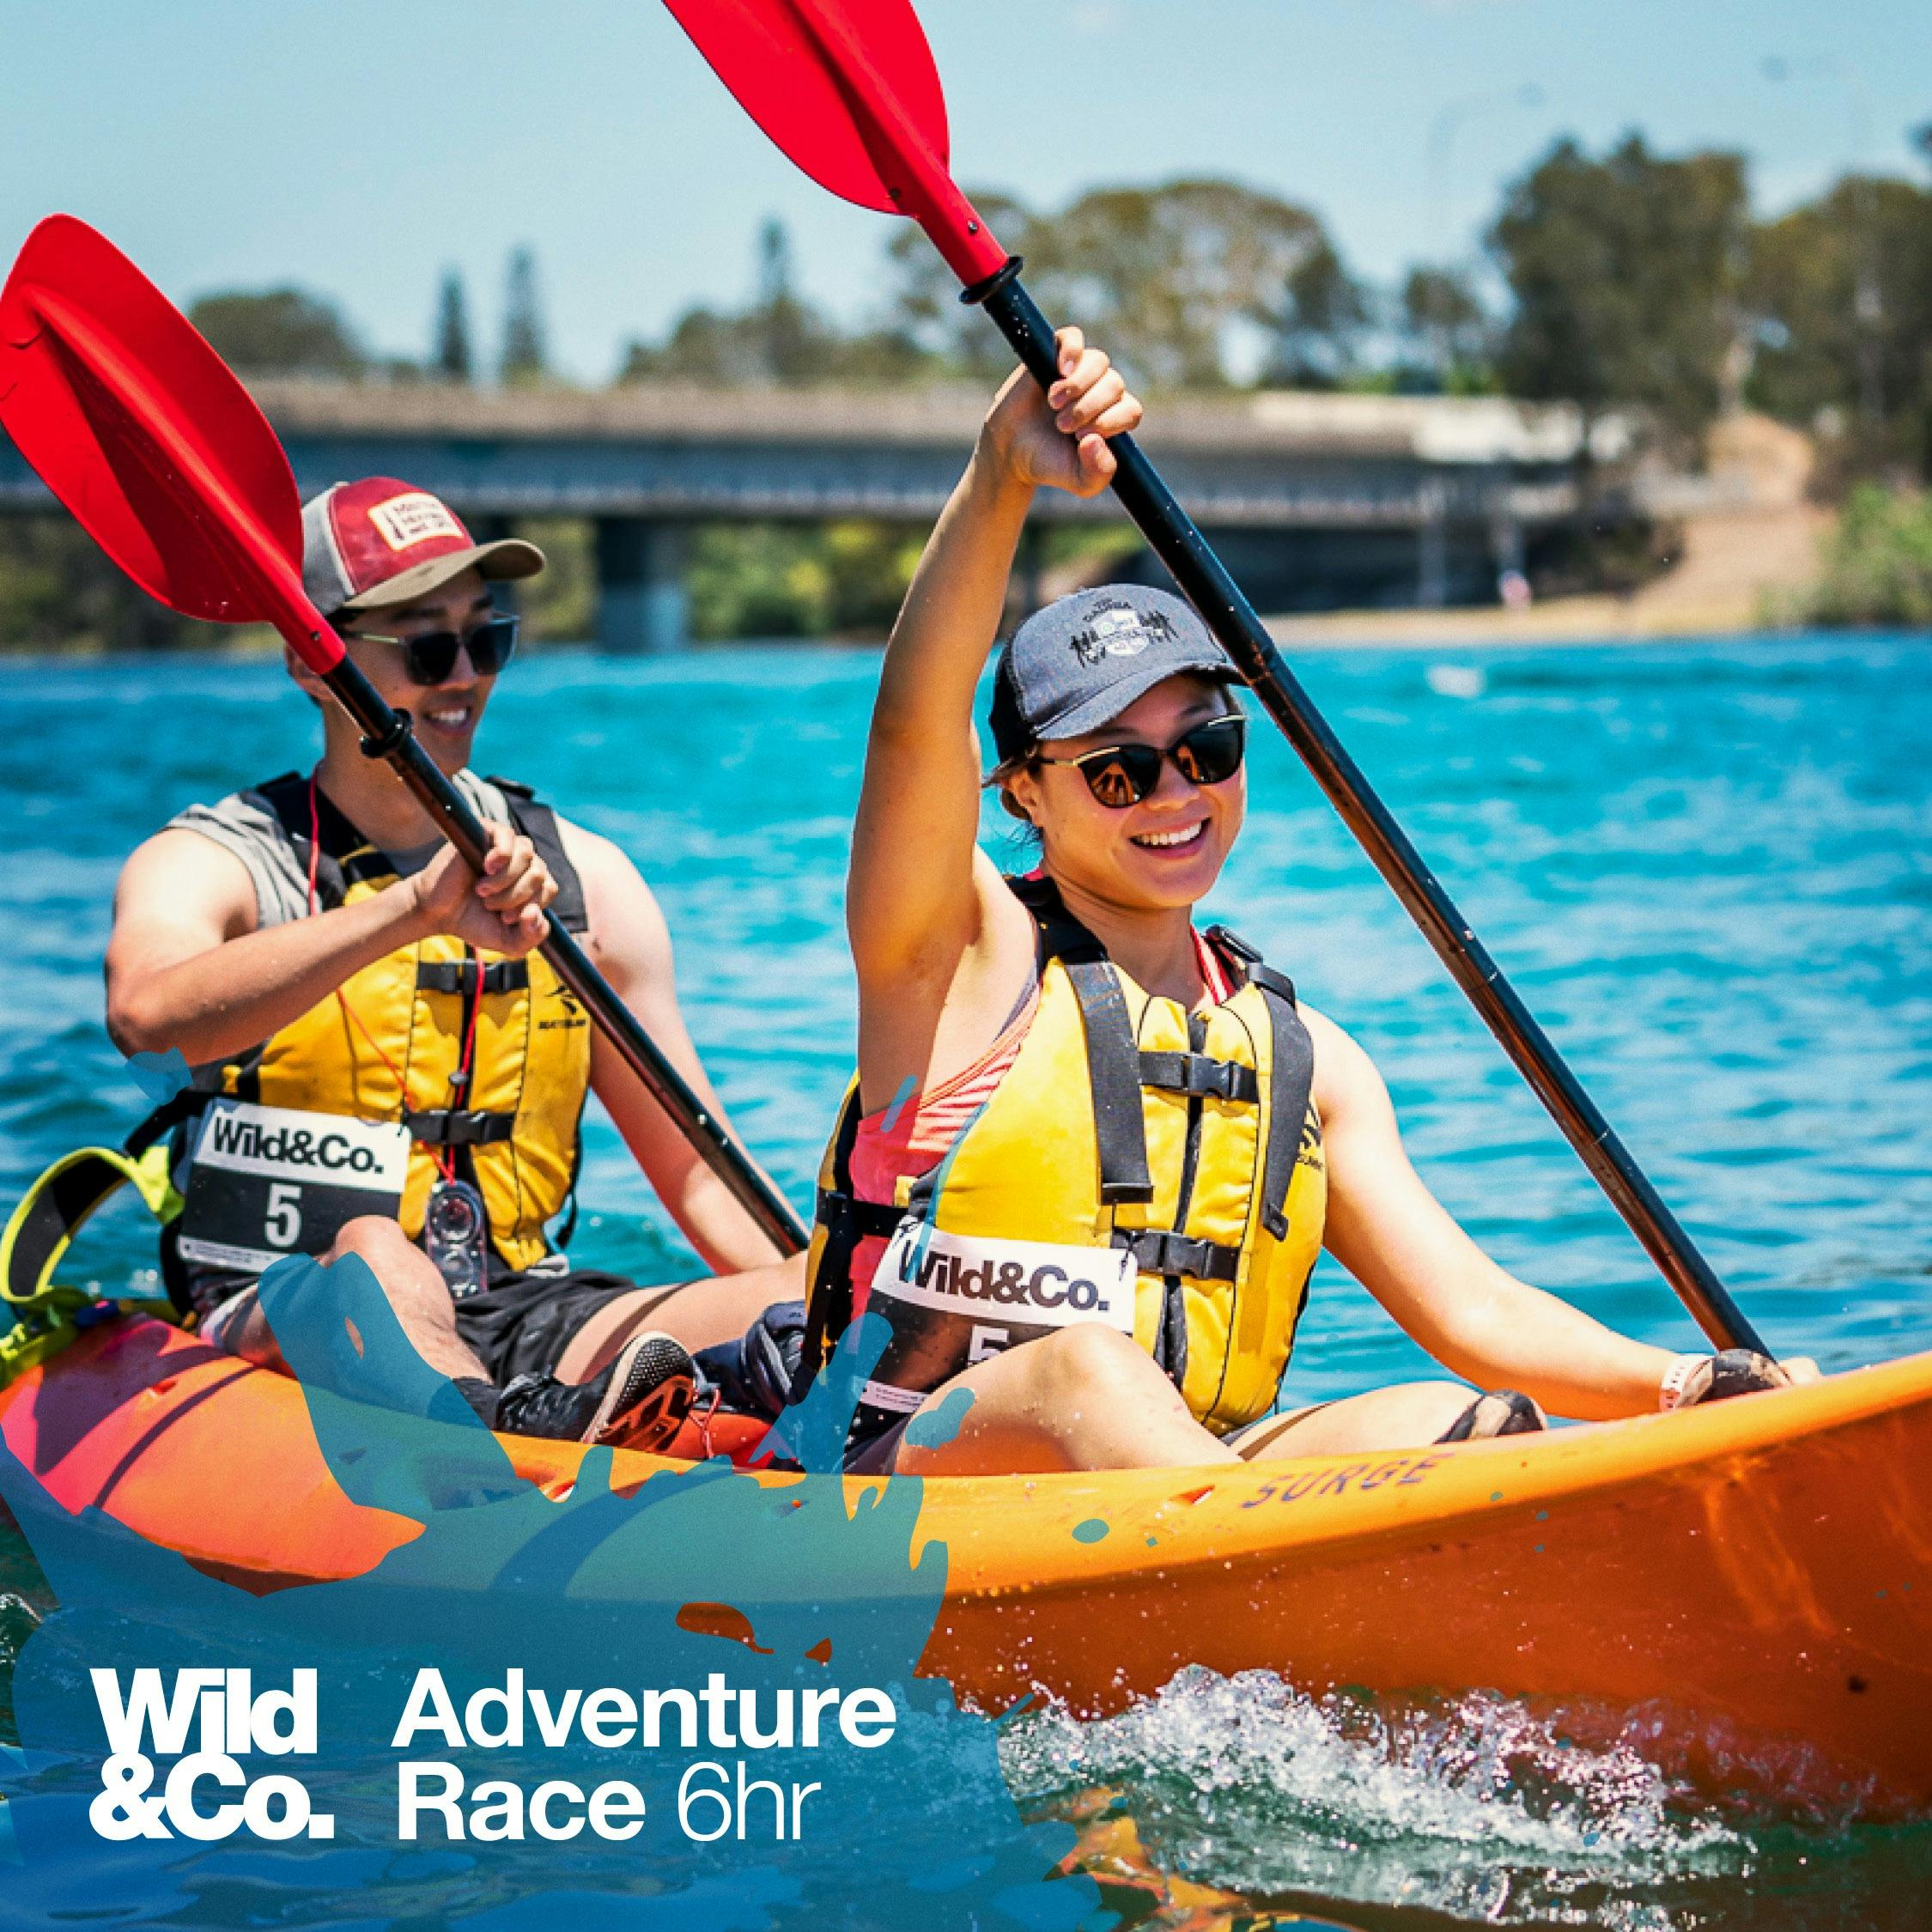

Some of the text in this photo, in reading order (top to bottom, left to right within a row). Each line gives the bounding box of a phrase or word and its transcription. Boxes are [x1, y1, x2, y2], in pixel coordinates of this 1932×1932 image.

[214, 1115, 385, 1175] Wild&Co.
[265, 1182, 301, 1248] 5
[898, 1239, 1110, 1312] Wild&Co.
[1240, 1451, 1456, 1509] SURGE
